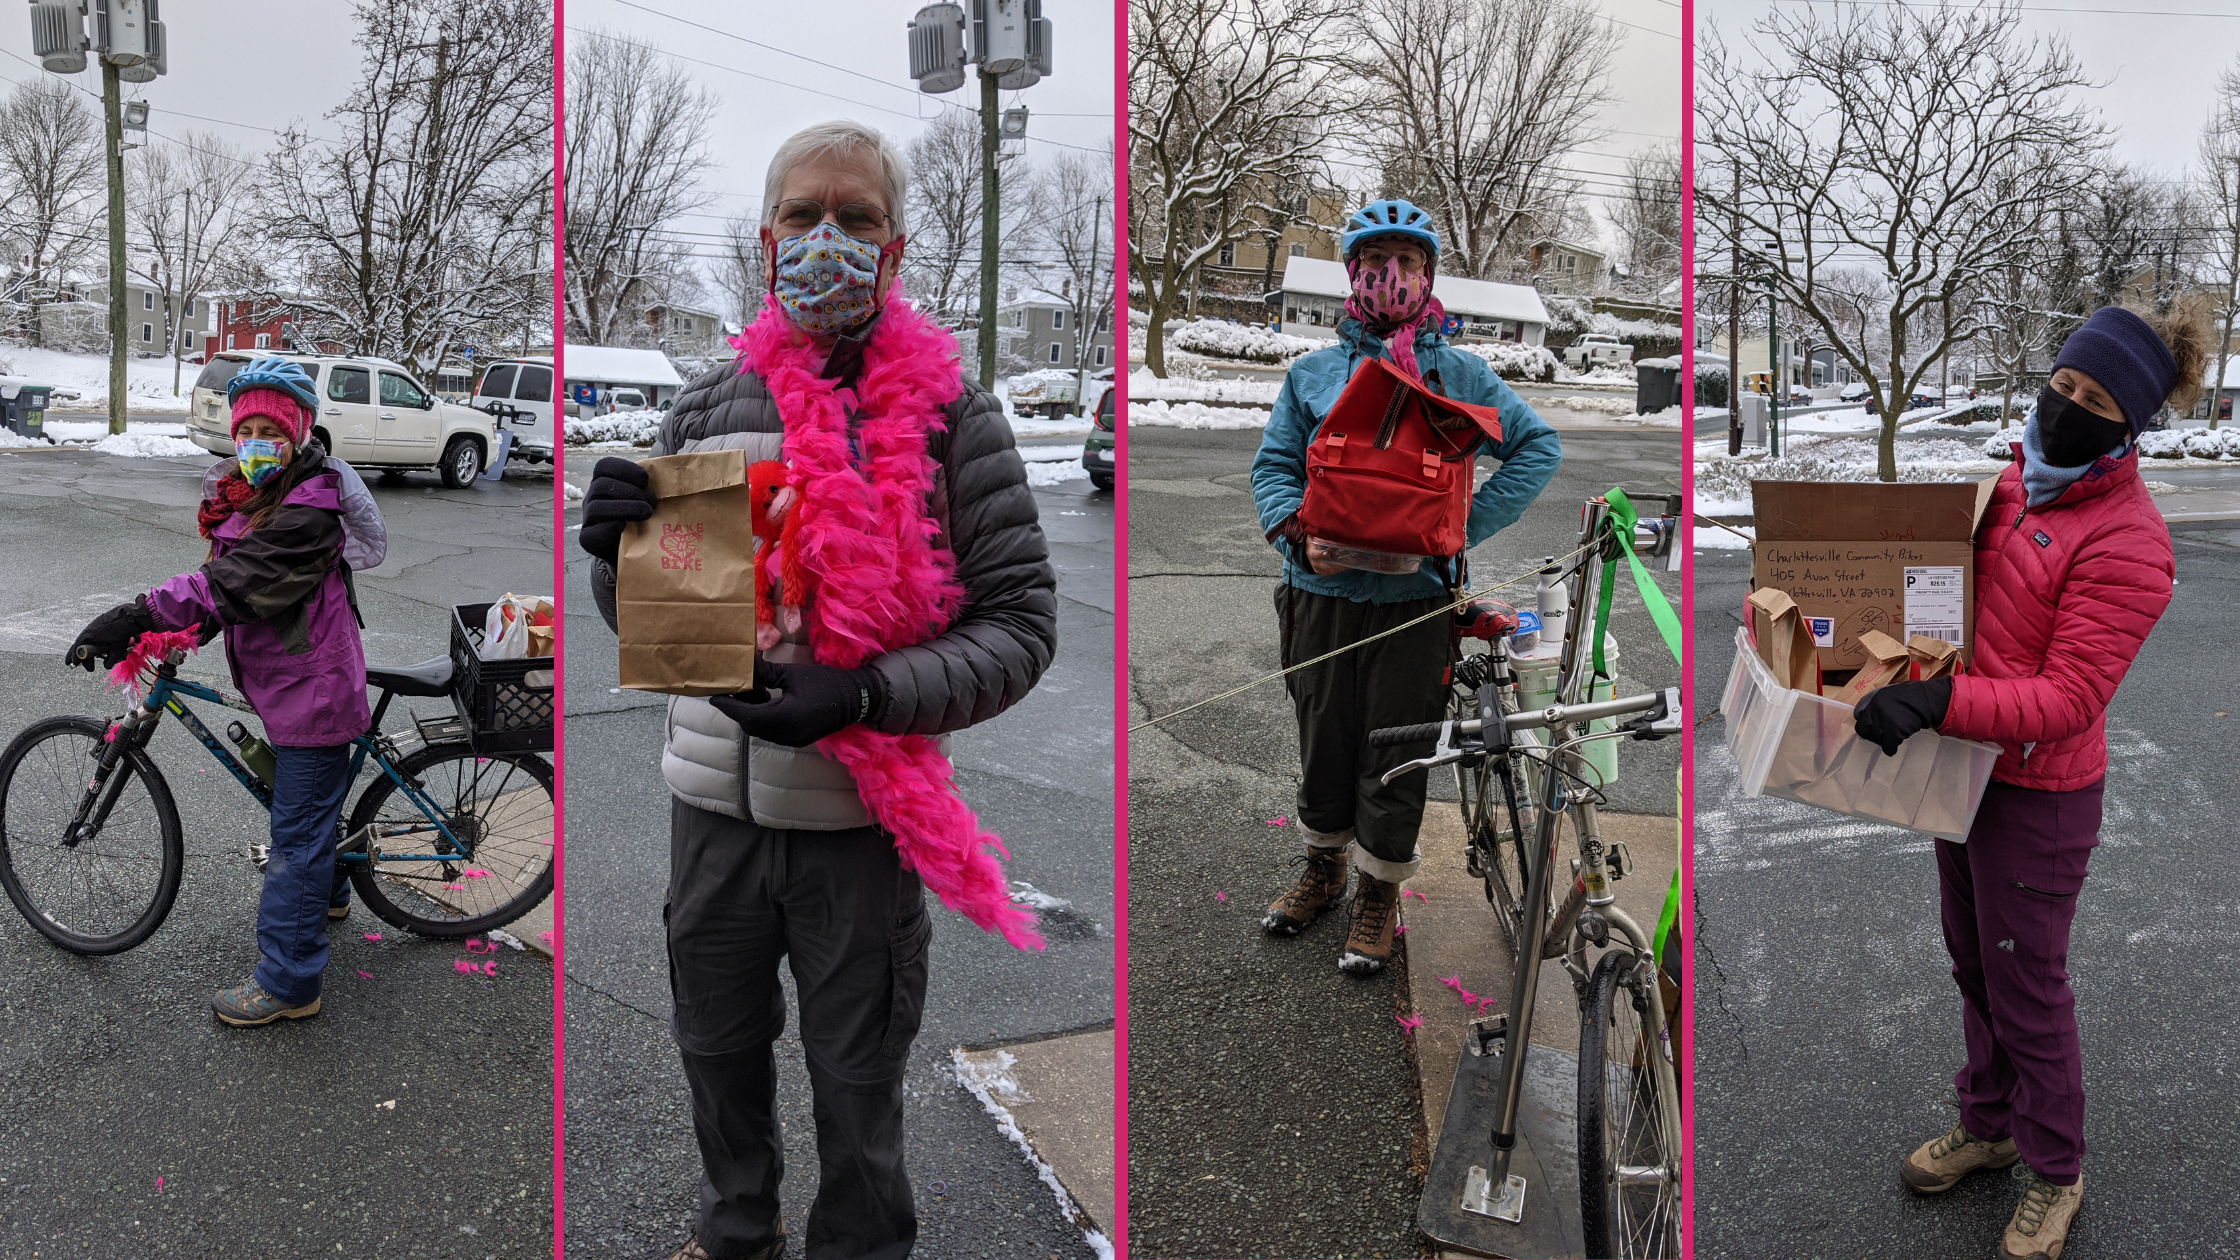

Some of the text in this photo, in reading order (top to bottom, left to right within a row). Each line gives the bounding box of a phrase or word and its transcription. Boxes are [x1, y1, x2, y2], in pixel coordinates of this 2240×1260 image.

[661, 522, 705, 535] BAKE
[1767, 548, 1923, 564] Charlottesville Community Bikes
[660, 556, 703, 572] BIKE
[1770, 567, 1866, 582] 405 Avon Street
[1906, 575, 1917, 588] P
[1840, 586, 1856, 598] VA
[1858, 586, 1895, 598] 22902
